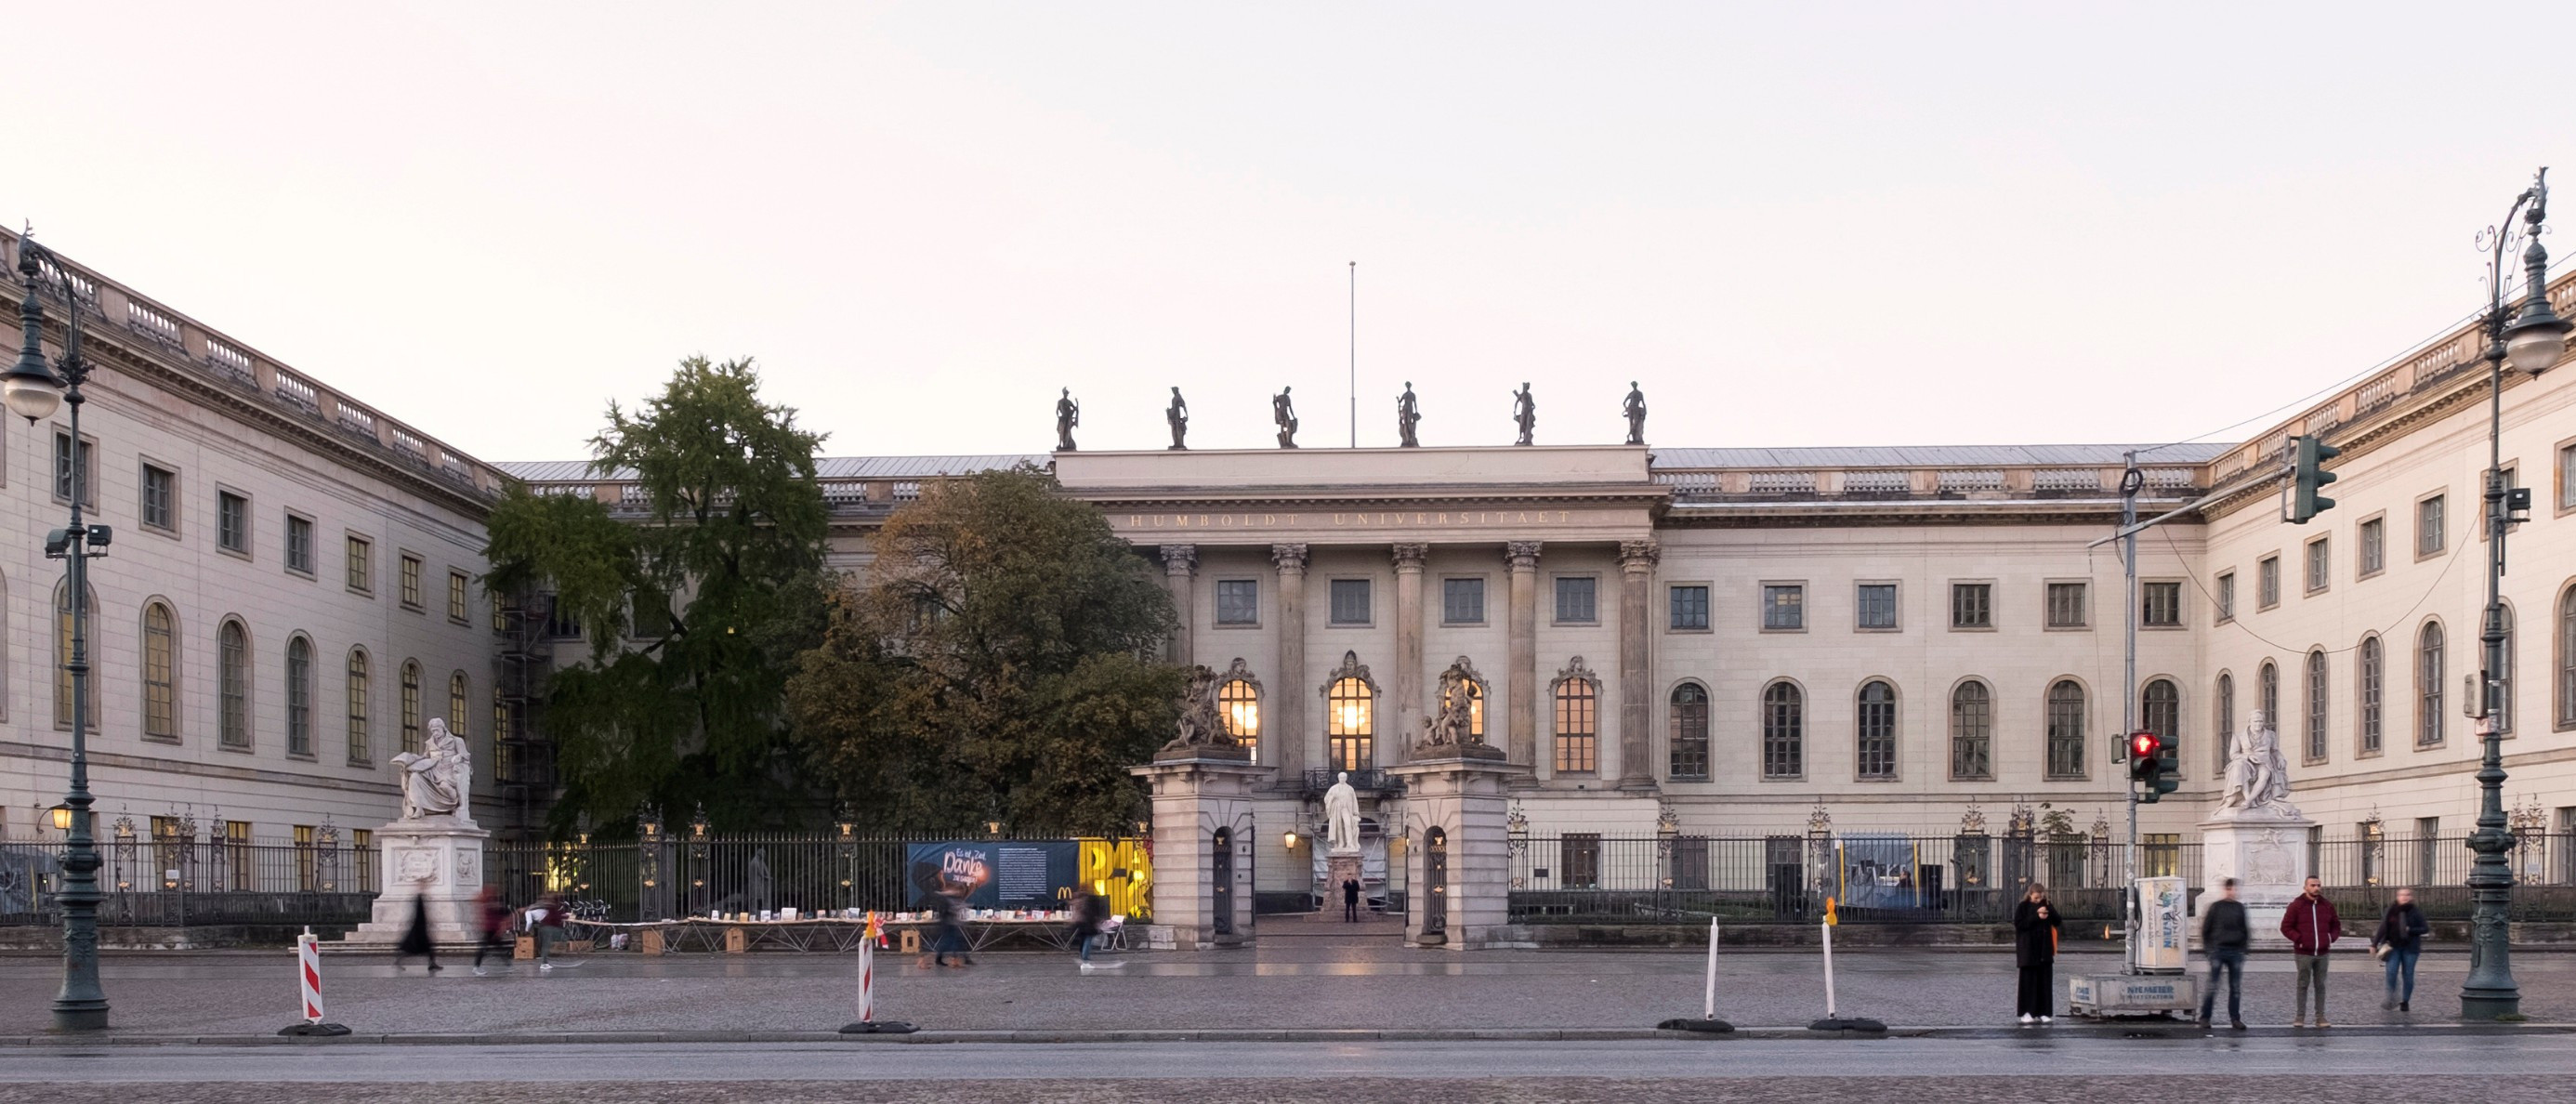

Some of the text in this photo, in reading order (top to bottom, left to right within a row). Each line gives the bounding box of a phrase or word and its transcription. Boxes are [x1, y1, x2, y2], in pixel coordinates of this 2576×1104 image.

[1130, 511, 1571, 527] HUMBOLDT UNIVERSITAET
[943, 851, 982, 875] Danke
